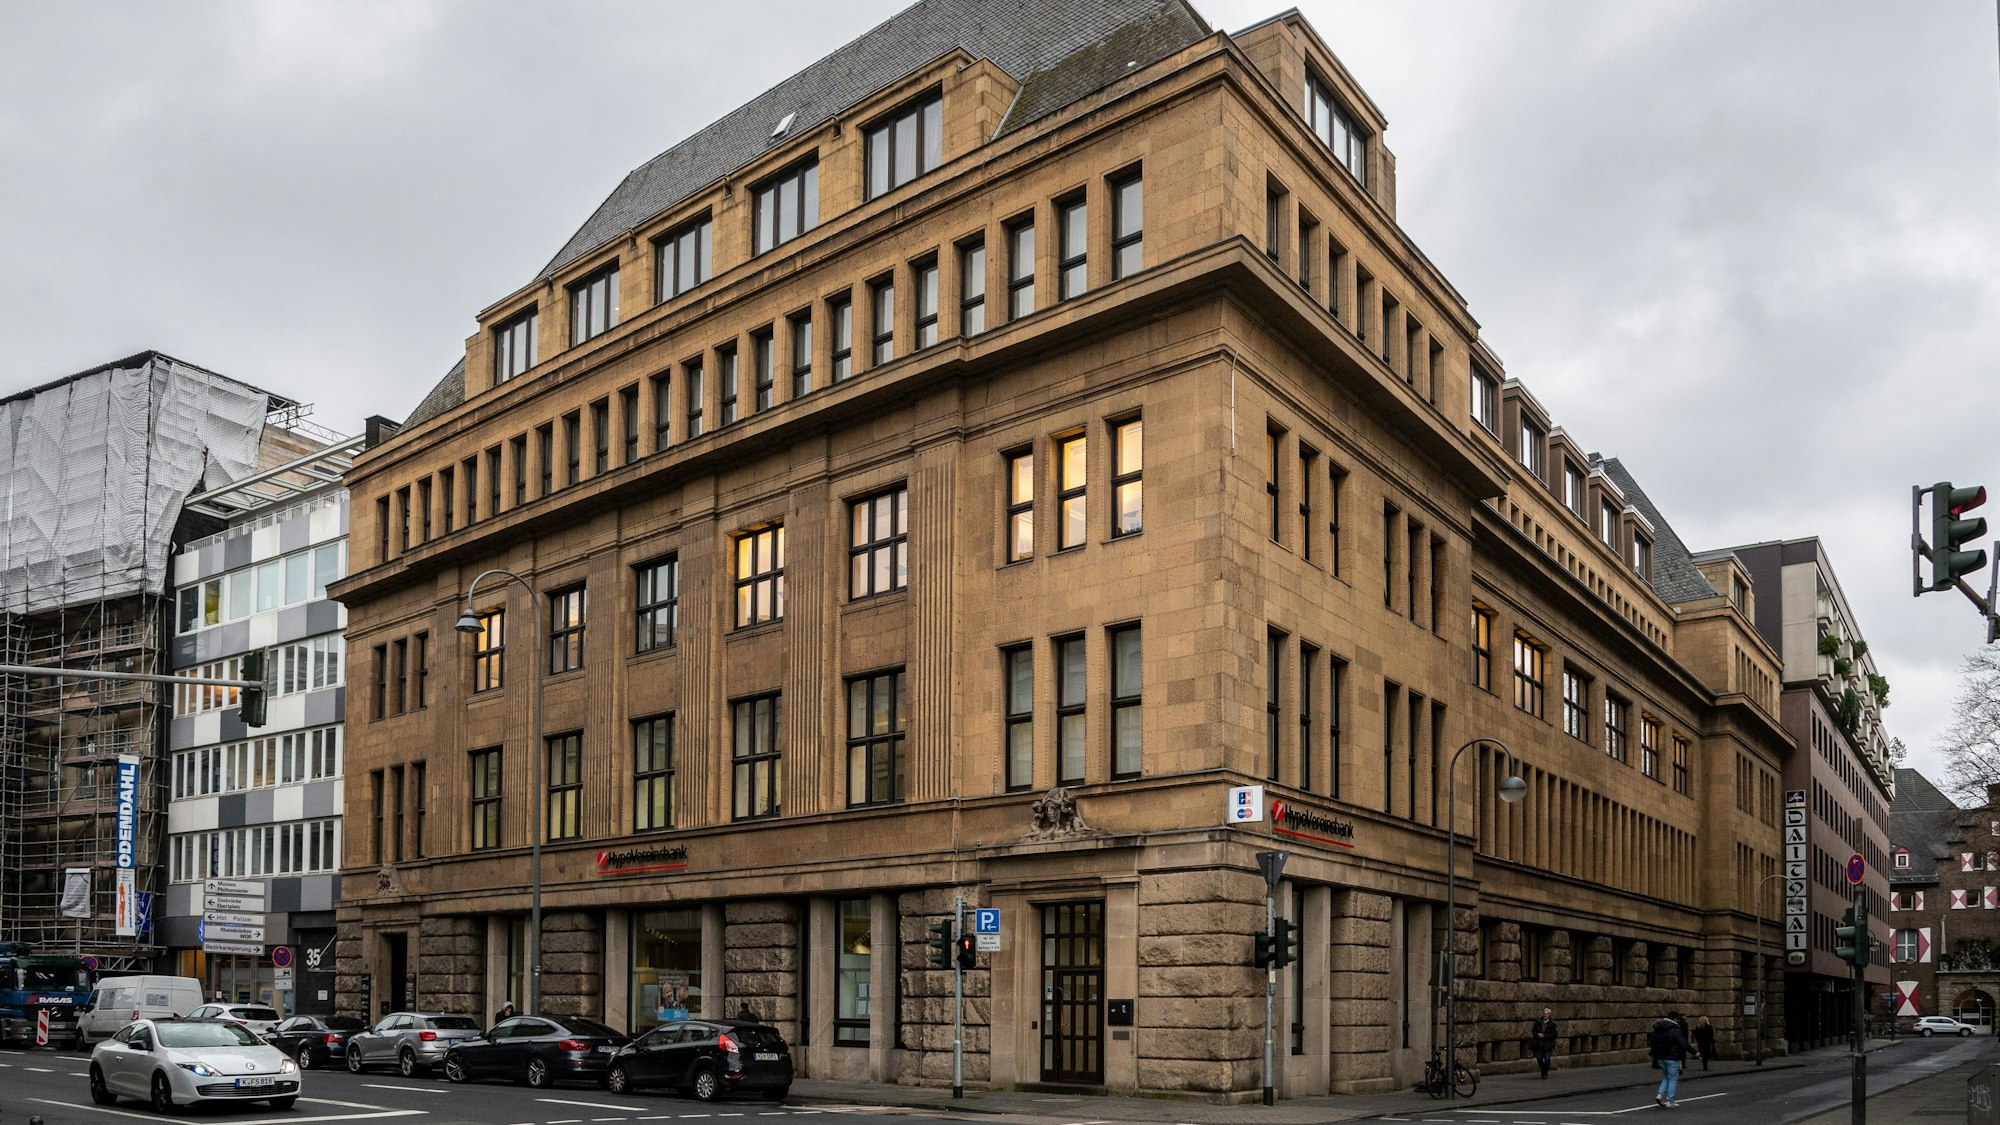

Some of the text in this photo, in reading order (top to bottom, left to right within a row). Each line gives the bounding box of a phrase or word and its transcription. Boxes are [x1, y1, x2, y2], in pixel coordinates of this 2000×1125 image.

[118, 764, 136, 868] ODENDAHL
[1285, 804, 1354, 839] HypoVereinsbank
[608, 844, 688, 869] HypoVereinsbank
[981, 911, 995, 930] P
[205, 944, 252, 952] Bezirksregierung
[306, 948, 321, 966] 35
